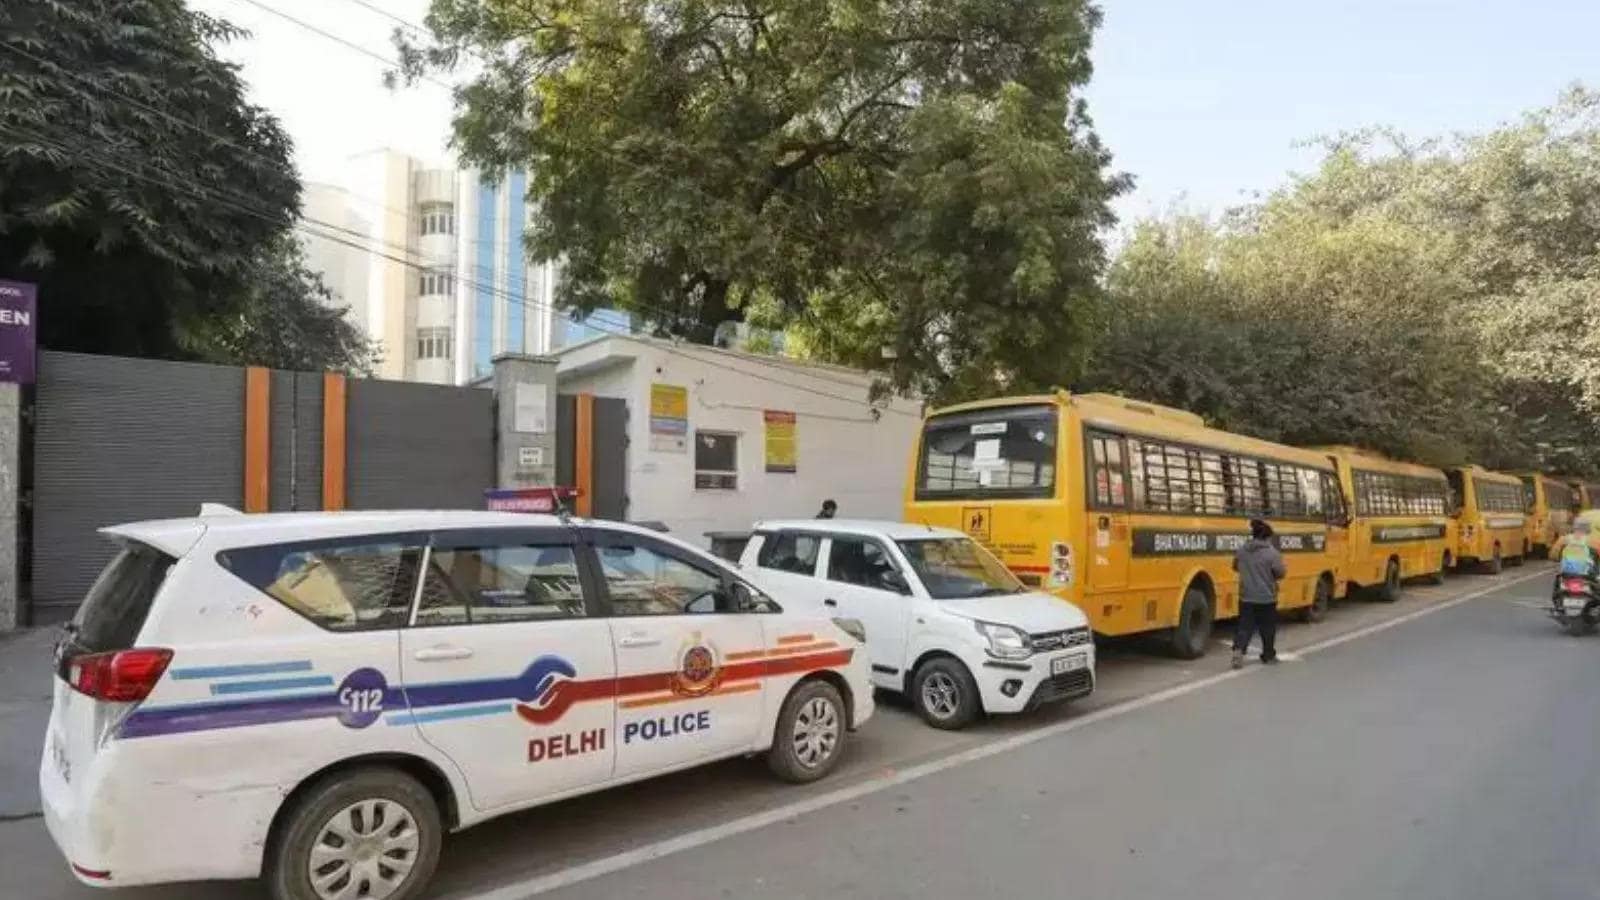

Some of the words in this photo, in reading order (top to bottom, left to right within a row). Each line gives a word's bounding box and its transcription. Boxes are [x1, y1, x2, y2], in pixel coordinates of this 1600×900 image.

[1154, 533, 1207, 551] BHATNAGAR
[528, 728, 606, 762] DELHI
[623, 710, 711, 744] POLICE
